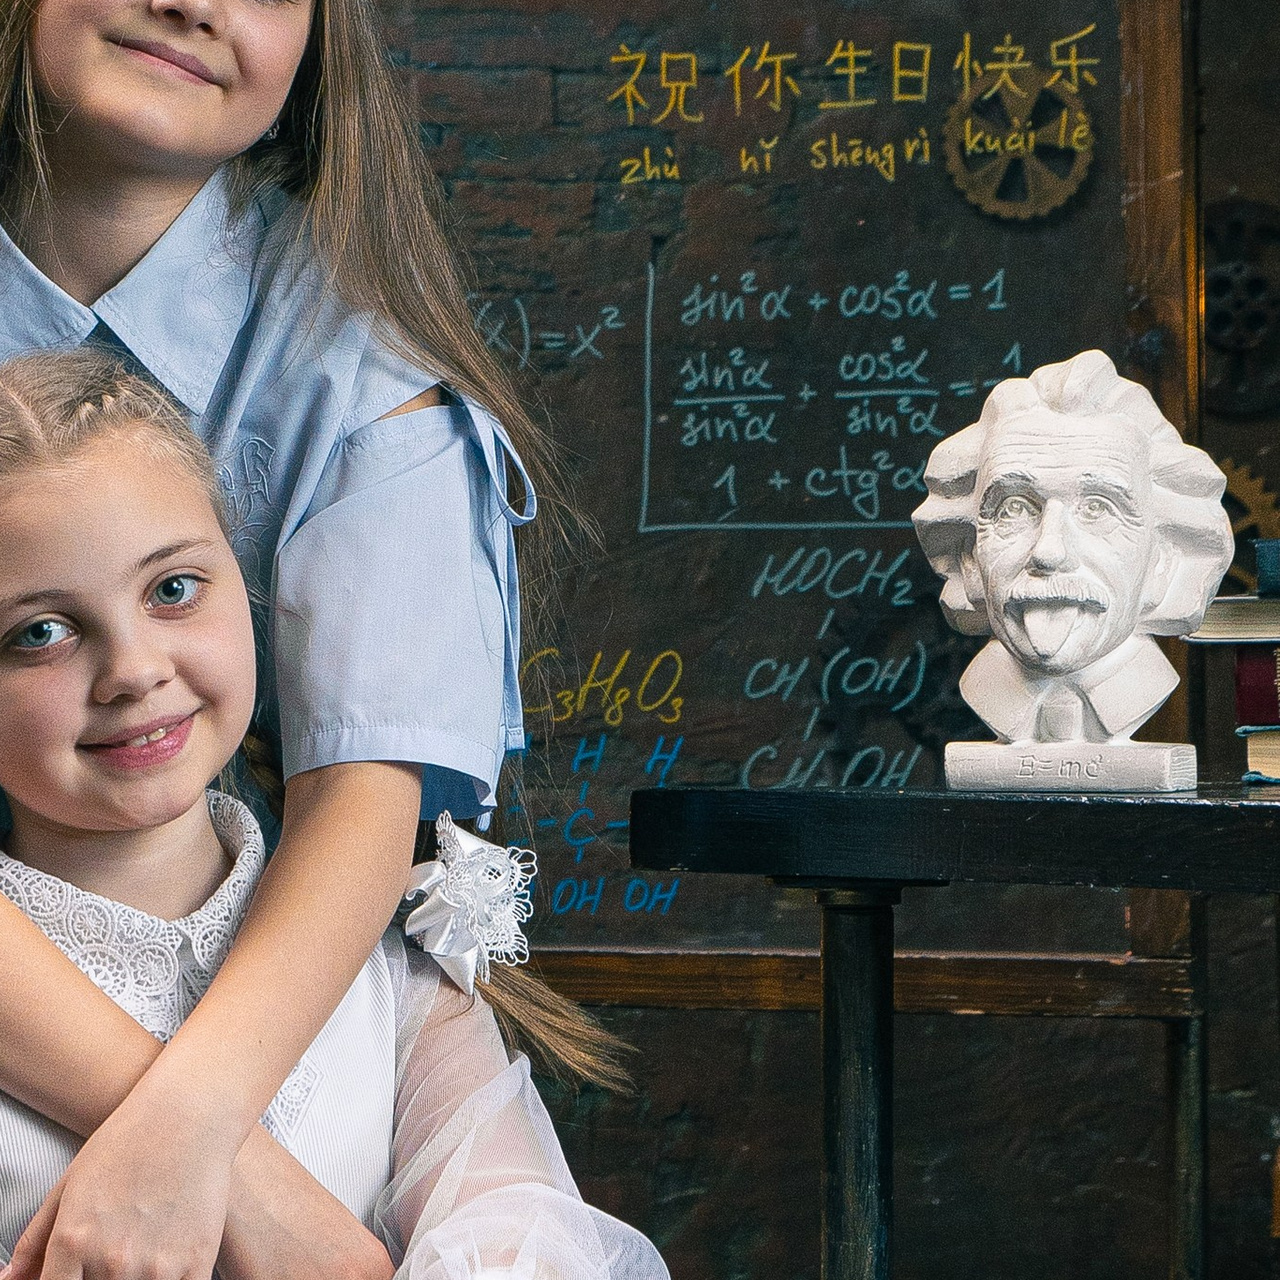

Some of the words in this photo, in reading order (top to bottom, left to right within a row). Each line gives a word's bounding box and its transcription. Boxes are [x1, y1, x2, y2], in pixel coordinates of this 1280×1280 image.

[607, 23, 1100, 125] 祝你生日快乐
